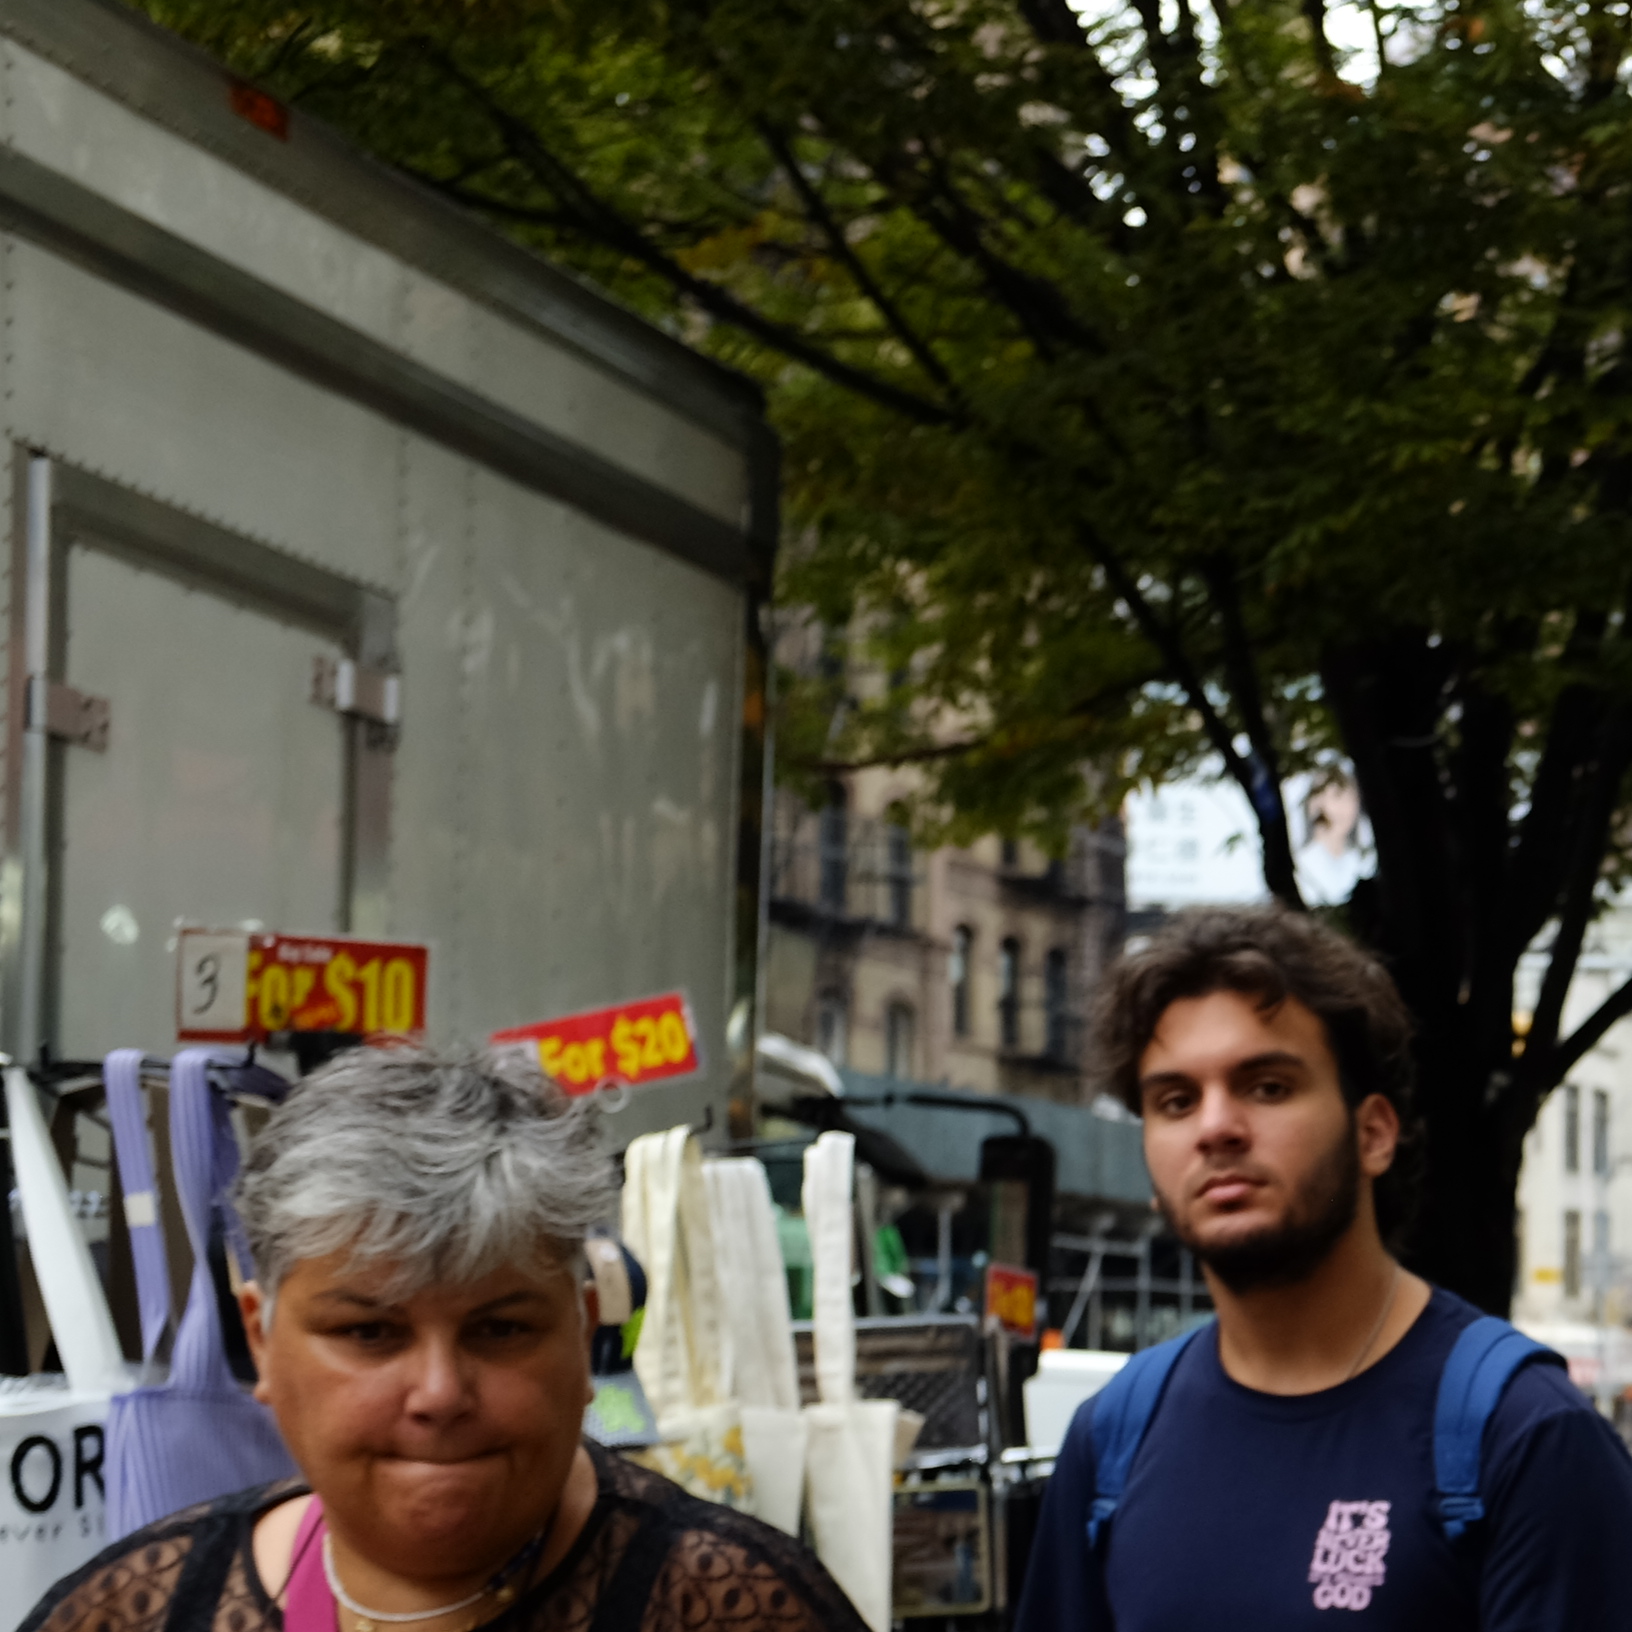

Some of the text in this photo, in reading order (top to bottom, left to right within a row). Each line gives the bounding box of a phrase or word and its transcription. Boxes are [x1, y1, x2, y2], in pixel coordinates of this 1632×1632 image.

[194, 951, 415, 1033] 3 For $10
[537, 1008, 690, 1086] For $20
[1312, 1585, 1372, 1611] GOD
